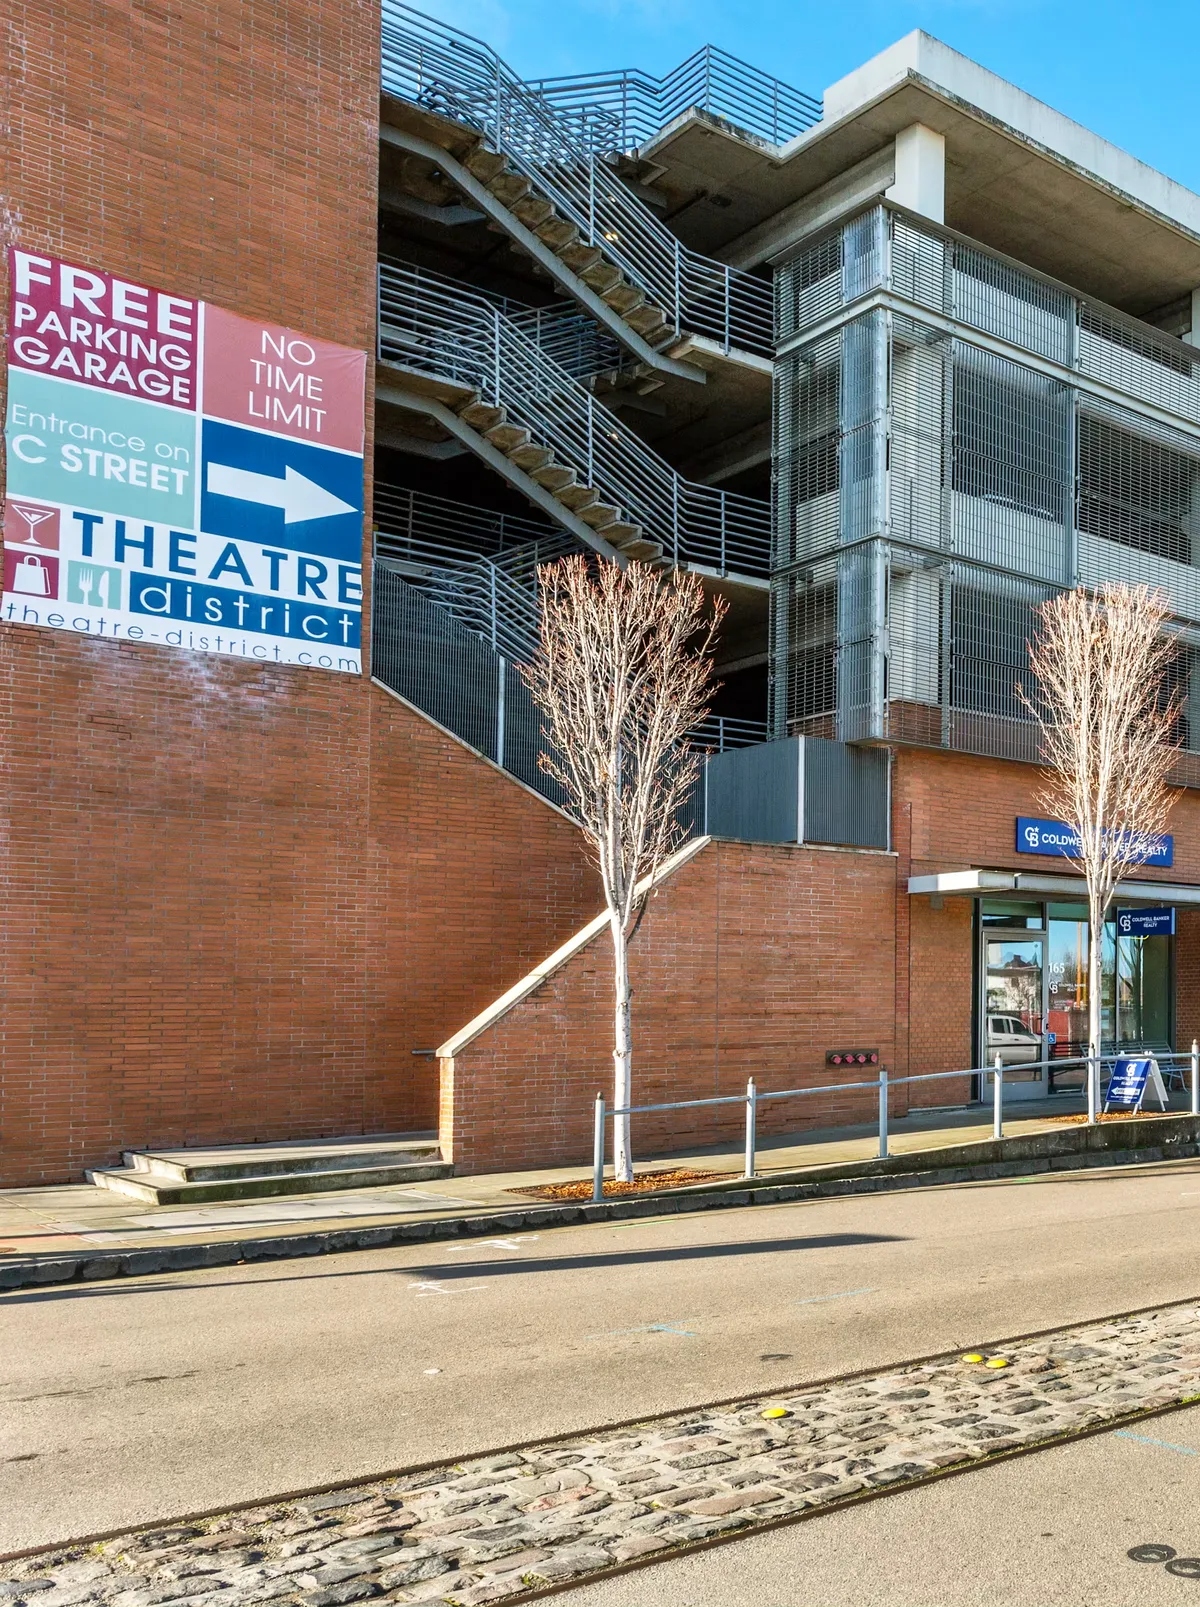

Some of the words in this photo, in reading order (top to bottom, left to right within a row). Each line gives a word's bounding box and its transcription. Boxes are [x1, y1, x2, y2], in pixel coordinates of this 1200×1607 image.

[14, 250, 193, 342] FREE
[14, 301, 192, 371] PARKING
[261, 330, 316, 366] NO
[13, 336, 191, 404] GARAGE
[250, 358, 323, 402] TIME
[12, 403, 146, 452] Entrance
[155, 443, 190, 464] on
[249, 390, 327, 432] LIMIT
[12, 434, 48, 464] C
[60, 443, 190, 495] STREET
[72, 511, 362, 605] THEATRE
[6, 602, 360, 673] theatre-district.com
[139, 582, 354, 644] district
[1048, 962, 1065, 973] 165
